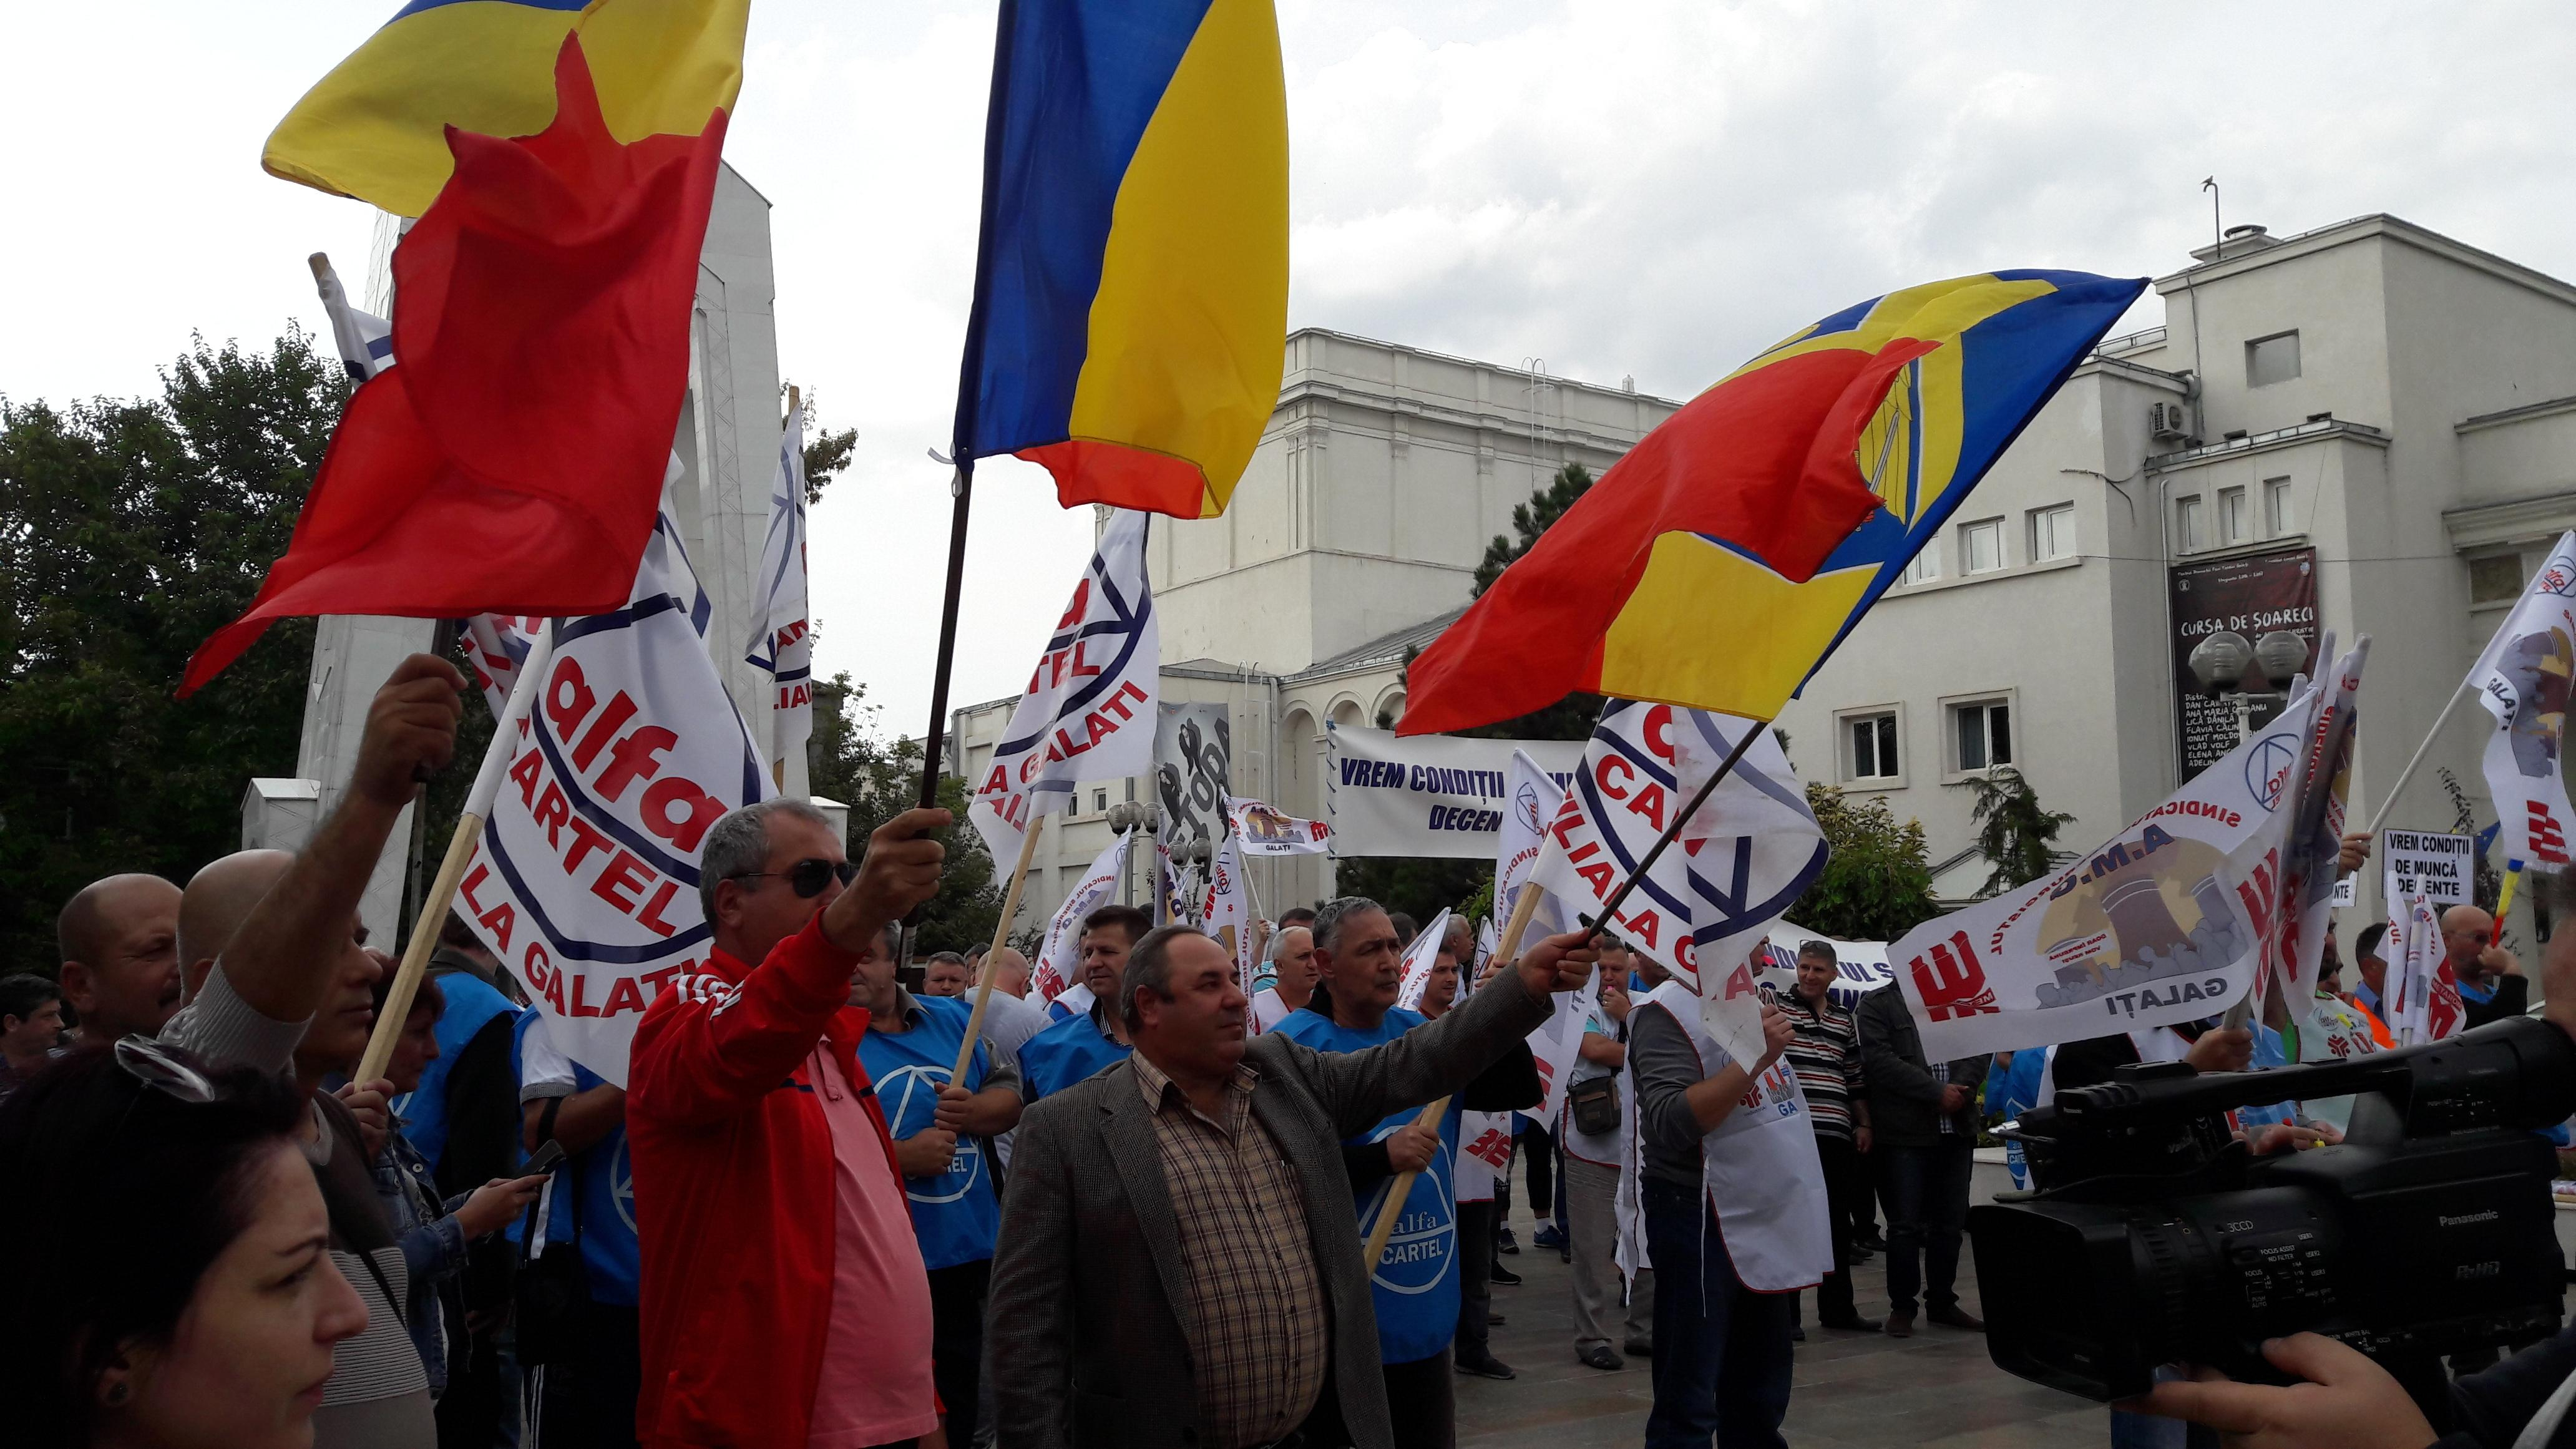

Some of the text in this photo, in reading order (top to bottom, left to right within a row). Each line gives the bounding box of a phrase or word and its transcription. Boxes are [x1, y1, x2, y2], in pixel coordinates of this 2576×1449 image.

[2180, 618, 2225, 637] CURSA
[2230, 614, 2248, 632] DE
[2185, 701, 2202, 710] DAN
[2185, 710, 2202, 718] ANA
[2204, 708, 2229, 716] MARIA
[2186, 724, 2213, 734] FLAVIA
[545, 655, 729, 854] alfa
[2187, 740, 2230, 751] VLAD VOLF
[2188, 750, 2213, 759] ELENA
[1341, 758, 1405, 789] VREM
[509, 745, 680, 938] ARTEL
[2389, 833, 2419, 851] VREM
[2395, 859, 2458, 878] DE MUNCĂ
[2398, 878, 2461, 896] DEENTE
[524, 941, 698, 1018] GALAT
[1391, 1211, 1438, 1234] alfa
[2227, 1219, 2254, 1232] 3CCD
[2438, 1208, 2499, 1227] Panasonic
[1379, 1237, 1443, 1266] CARTEL
